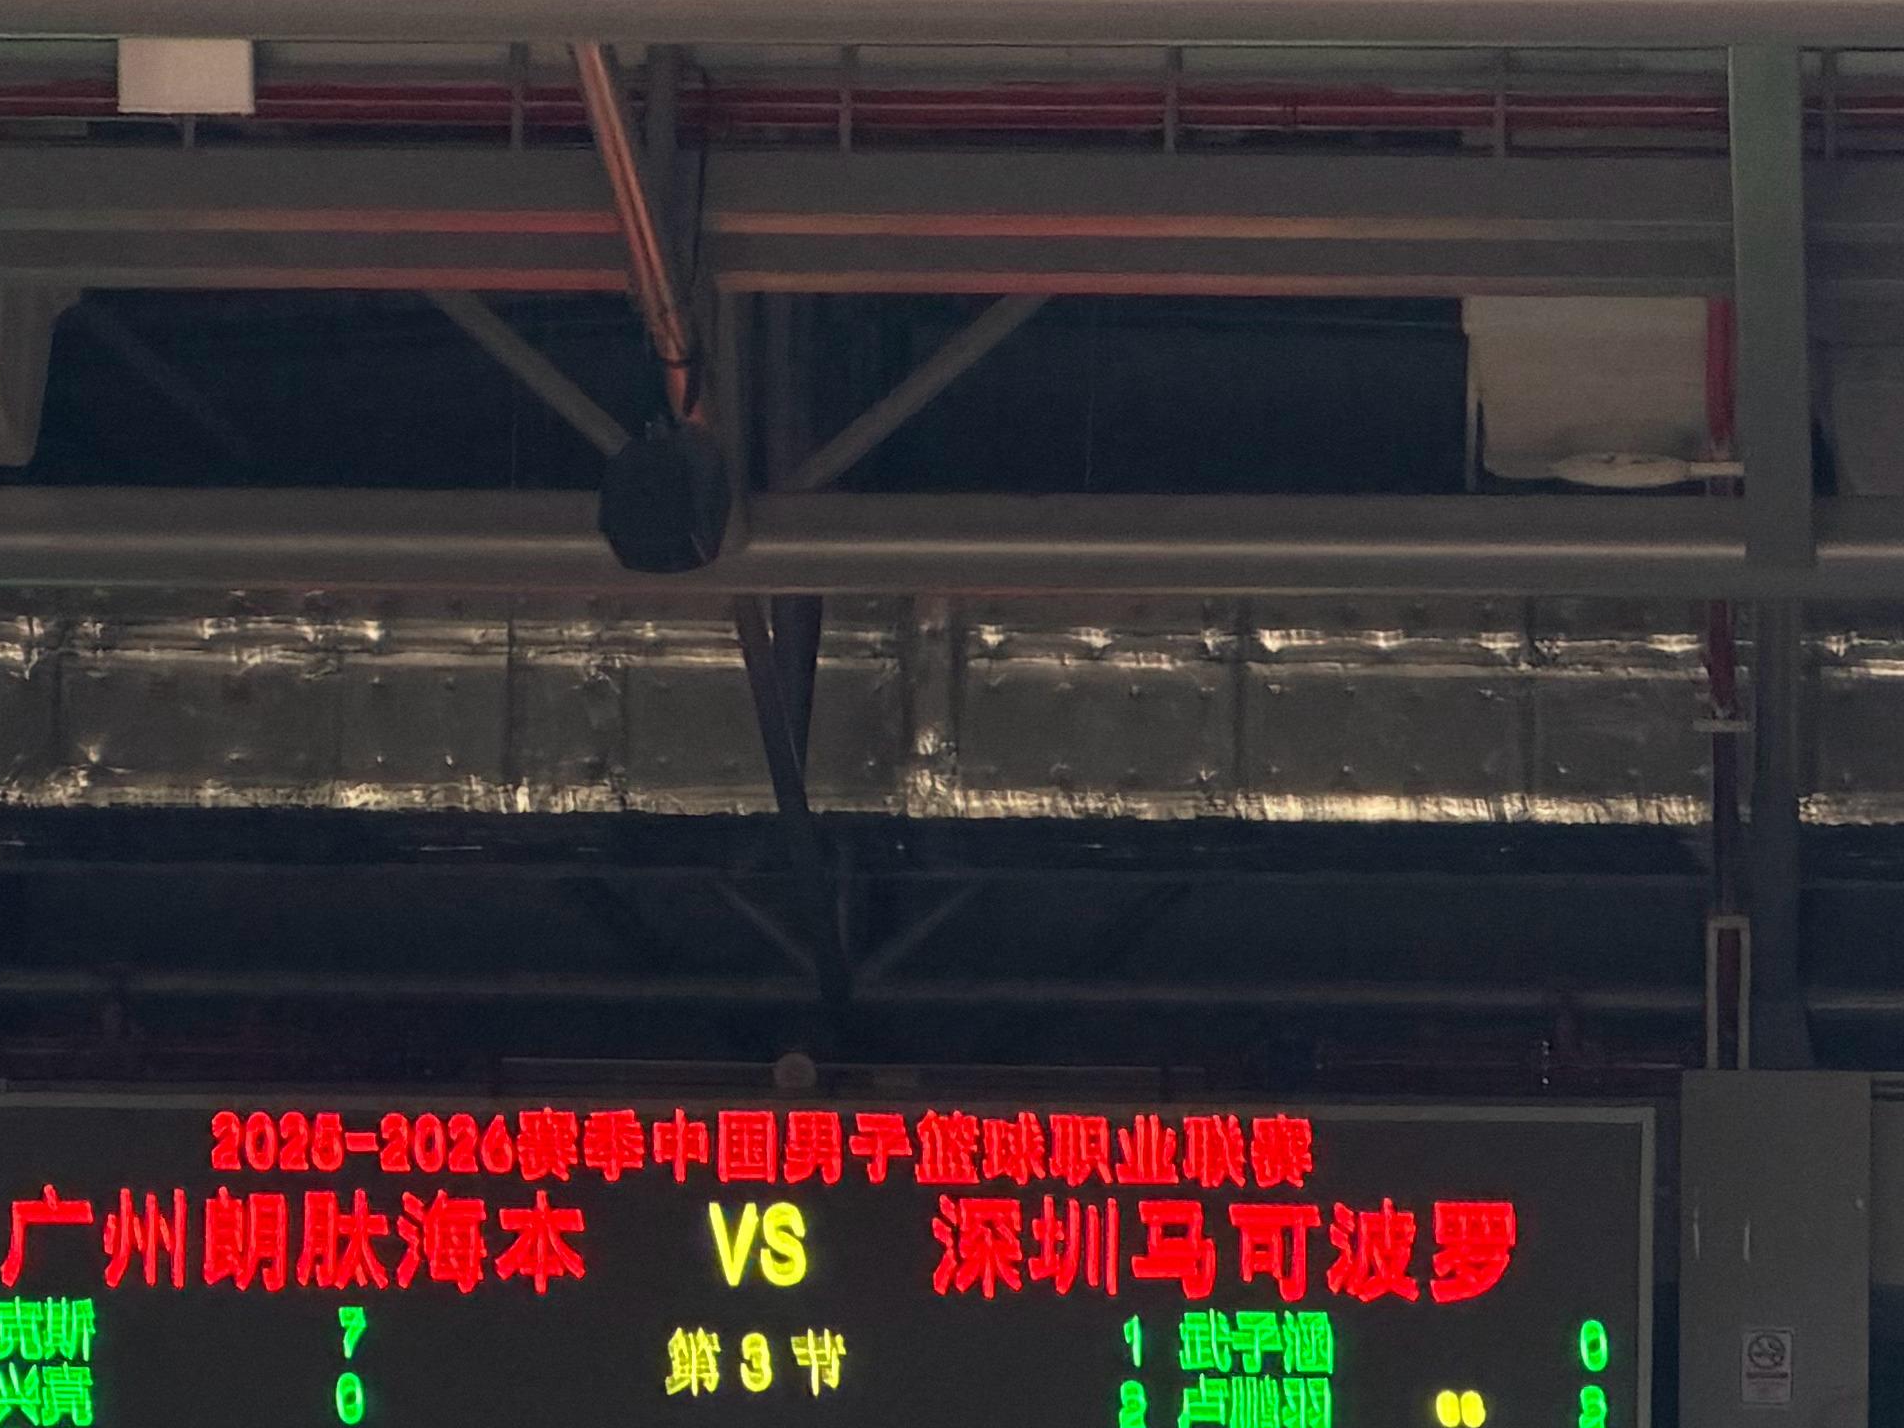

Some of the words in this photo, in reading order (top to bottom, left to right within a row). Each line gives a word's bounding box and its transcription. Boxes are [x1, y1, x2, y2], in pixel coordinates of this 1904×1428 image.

[212, 1107, 1313, 1187] 2025-2026赛季中国男子篮球职业联赛
[0, 1184, 585, 1294] 广州朗肽海本
[709, 1202, 807, 1286] VS
[932, 1195, 1516, 1303] 深圳马可波罗
[339, 1307, 366, 1358] 7
[1124, 1316, 1142, 1367] 1
[1580, 1320, 1608, 1371] 0
[742, 1333, 772, 1392] 3
[336, 1373, 364, 1424] 0
